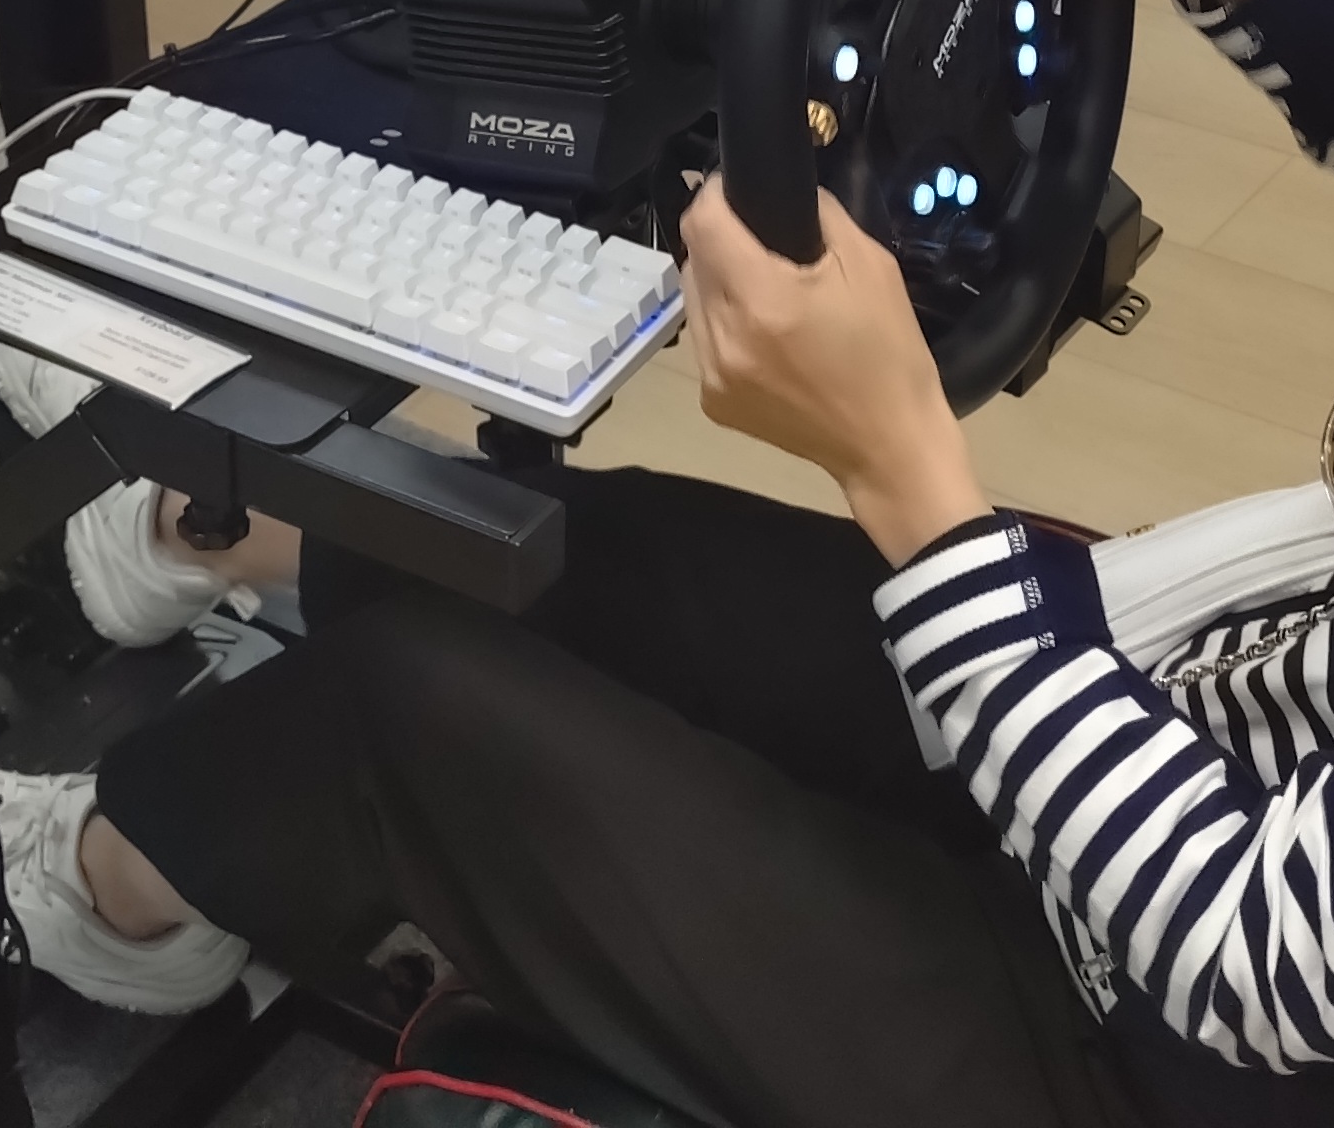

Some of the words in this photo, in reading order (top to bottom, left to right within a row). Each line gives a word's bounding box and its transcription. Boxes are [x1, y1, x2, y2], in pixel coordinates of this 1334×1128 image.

[469, 111, 575, 142] MOZA
[467, 133, 575, 157] RACING
[139, 314, 196, 341] Keyboard
